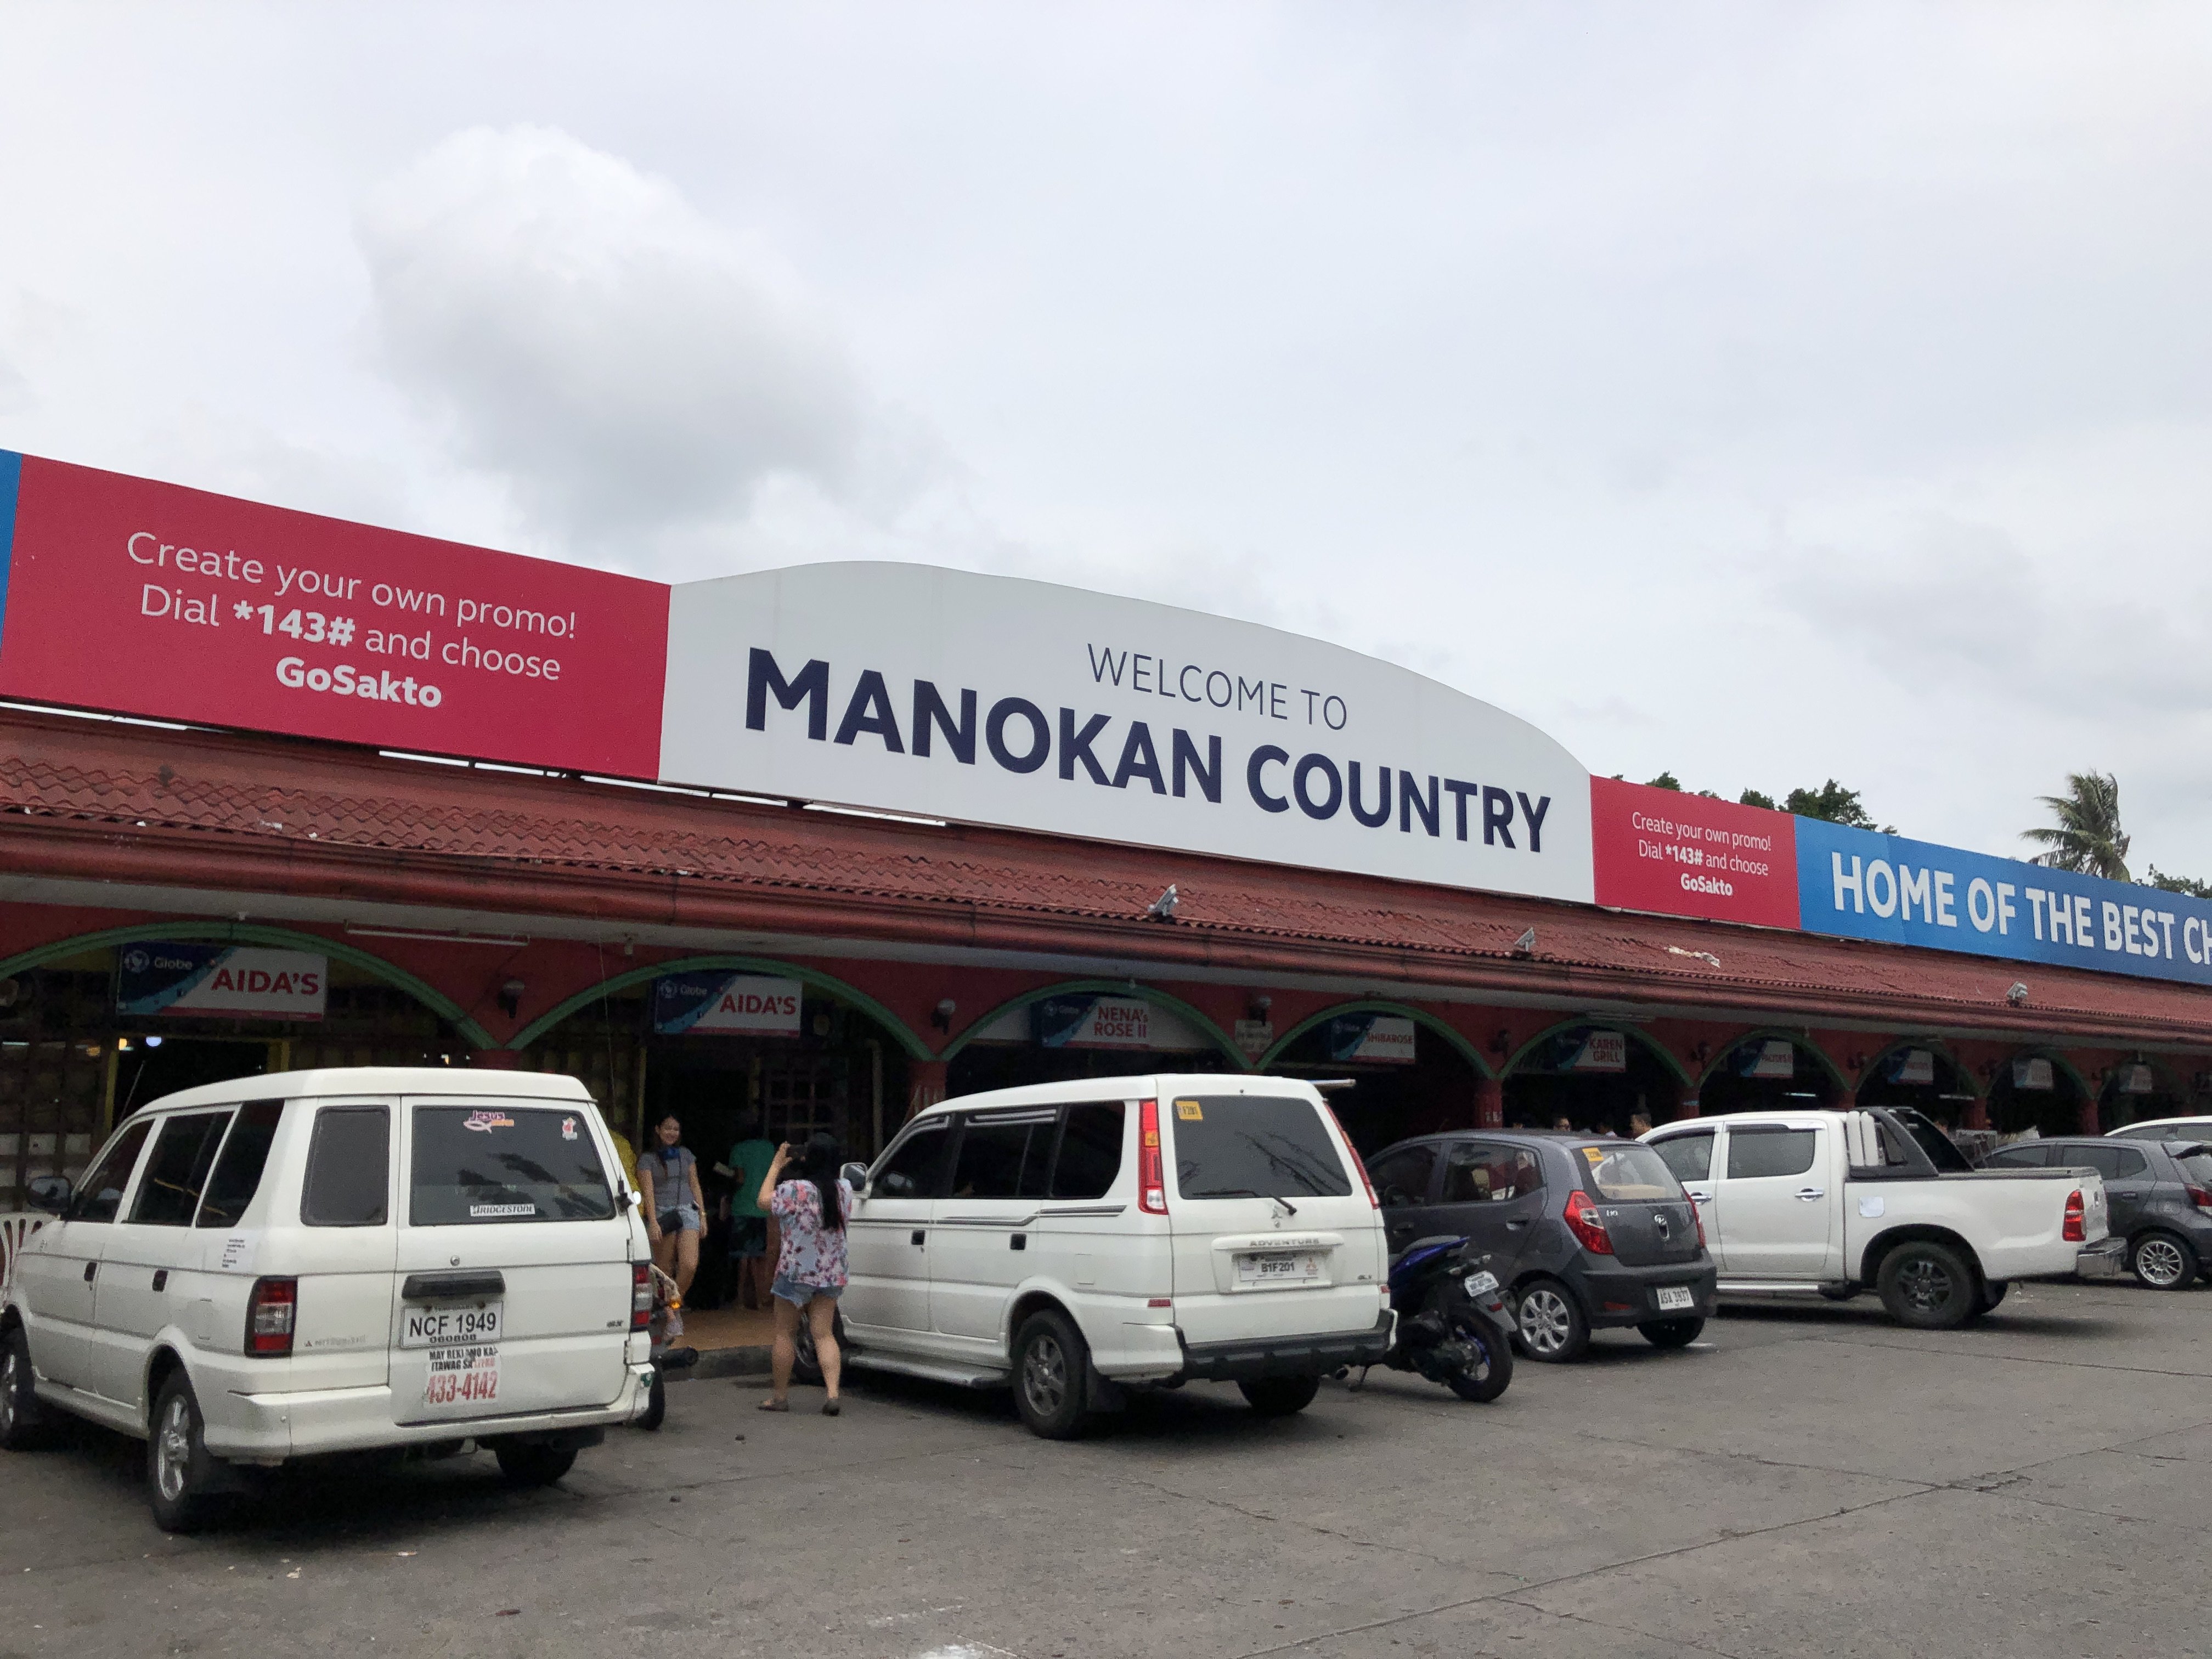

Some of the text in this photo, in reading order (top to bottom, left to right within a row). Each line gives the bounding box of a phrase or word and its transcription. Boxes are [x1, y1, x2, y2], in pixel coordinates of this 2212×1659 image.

[127, 532, 575, 637] Create your own promo!
[141, 584, 219, 627] Dial
[365, 630, 431, 660] and
[442, 636, 561, 680] choose
[276, 656, 442, 708] GoSakto
[1087, 642, 1347, 731] WELCOME TO
[744, 646, 1551, 854] MANOKAN COUNTRY
[1632, 811, 1771, 851] Create your own promo!
[1639, 839, 1663, 860] Dial
[1706, 853, 1727, 870] and
[1729, 854, 1769, 876] choose
[1680, 873, 1733, 896] GoSakto
[1832, 851, 1958, 927] HOME
[1967, 878, 2016, 935] OF
[2025, 887, 2094, 947] THE
[2102, 901, 2175, 960] BEST
[154, 956, 193, 970] Globe
[211, 968, 319, 995] AIDA'S
[719, 993, 796, 1015] AIDA'S
[1094, 1022, 1133, 1037] ROSE
[1593, 1050, 1620, 1063] GRILL
[470, 1110, 505, 1121] Jesus
[410, 1312, 496, 1338] NCF 1949
[430, 1350, 444, 1359] MAY
[427, 1370, 498, 1404] 433-4142
